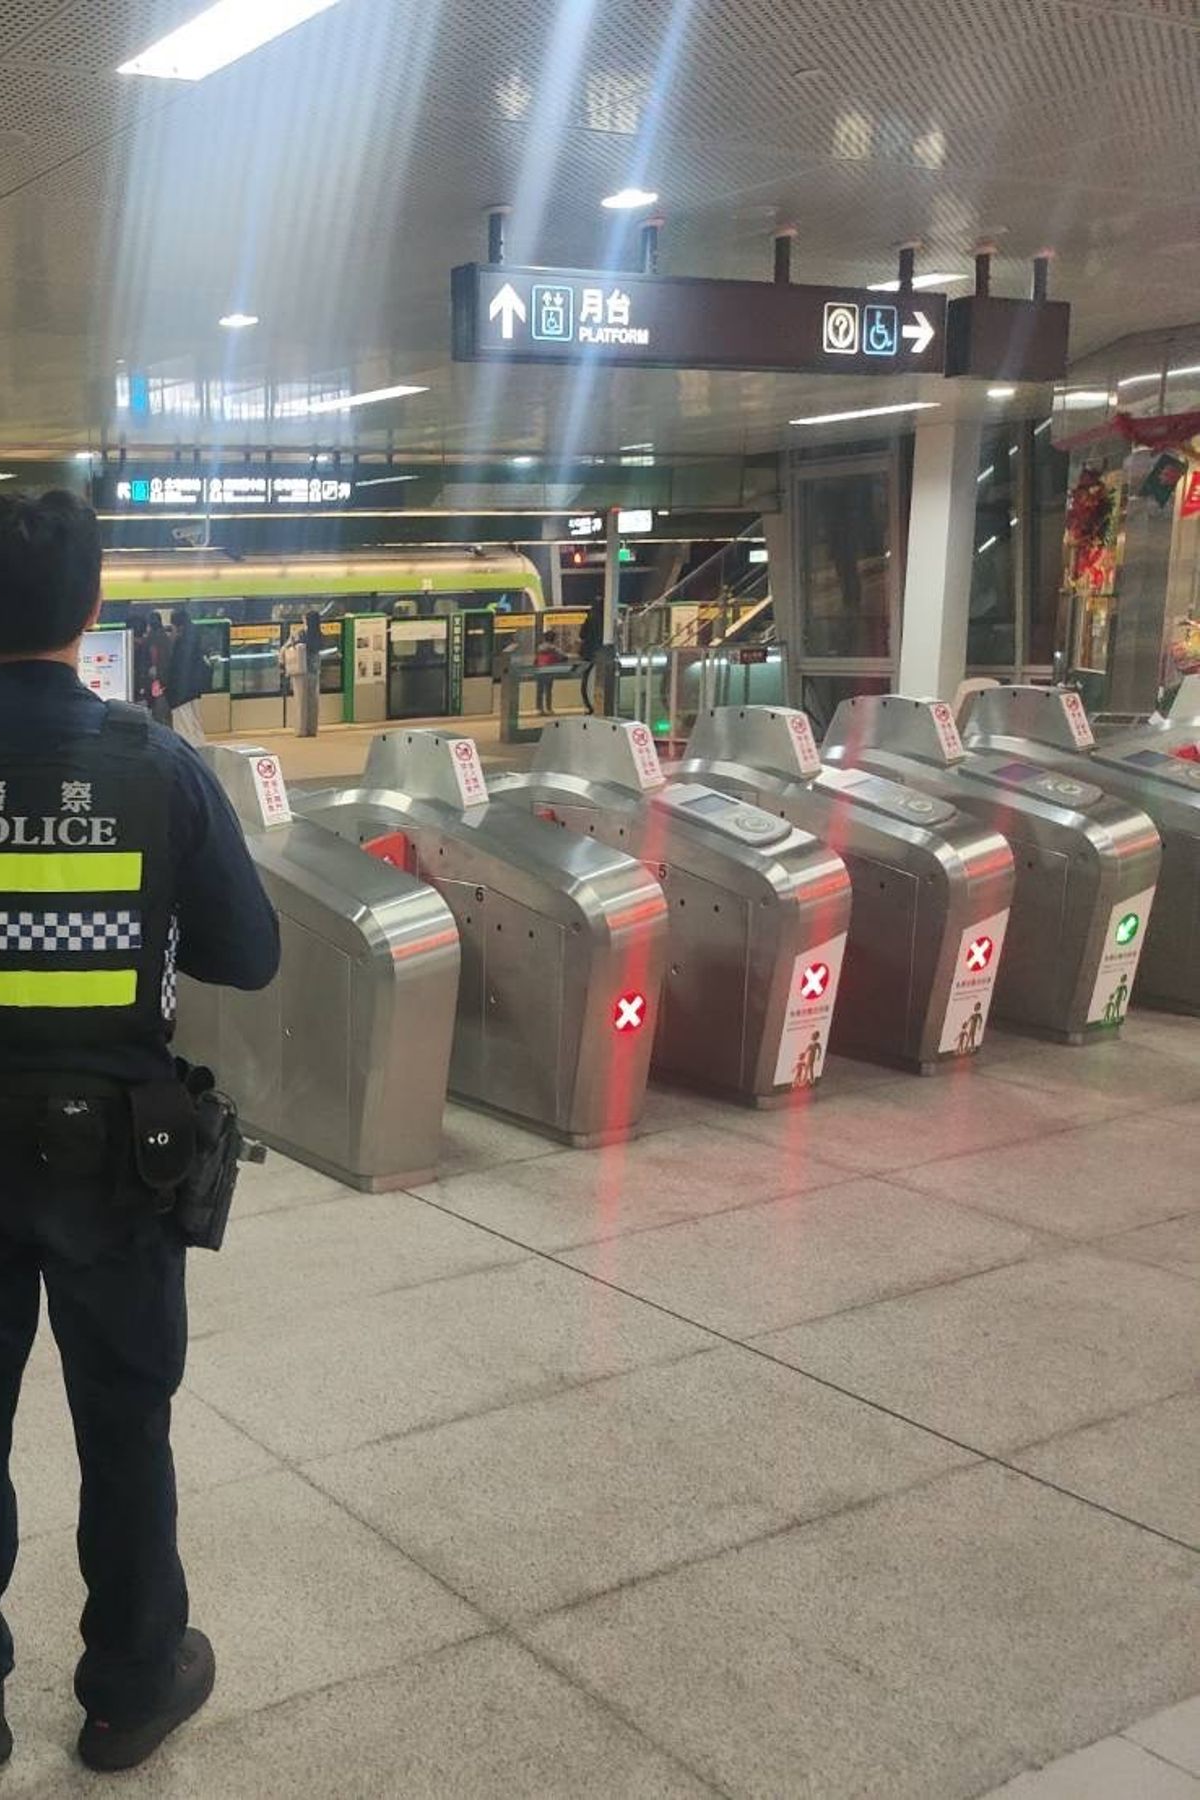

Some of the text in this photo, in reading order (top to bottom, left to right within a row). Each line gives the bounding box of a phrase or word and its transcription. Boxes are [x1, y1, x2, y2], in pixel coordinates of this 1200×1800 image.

[579, 288, 632, 324] 月台
[578, 327, 649, 345] PLATFORM
[475, 886, 485, 902] 6
